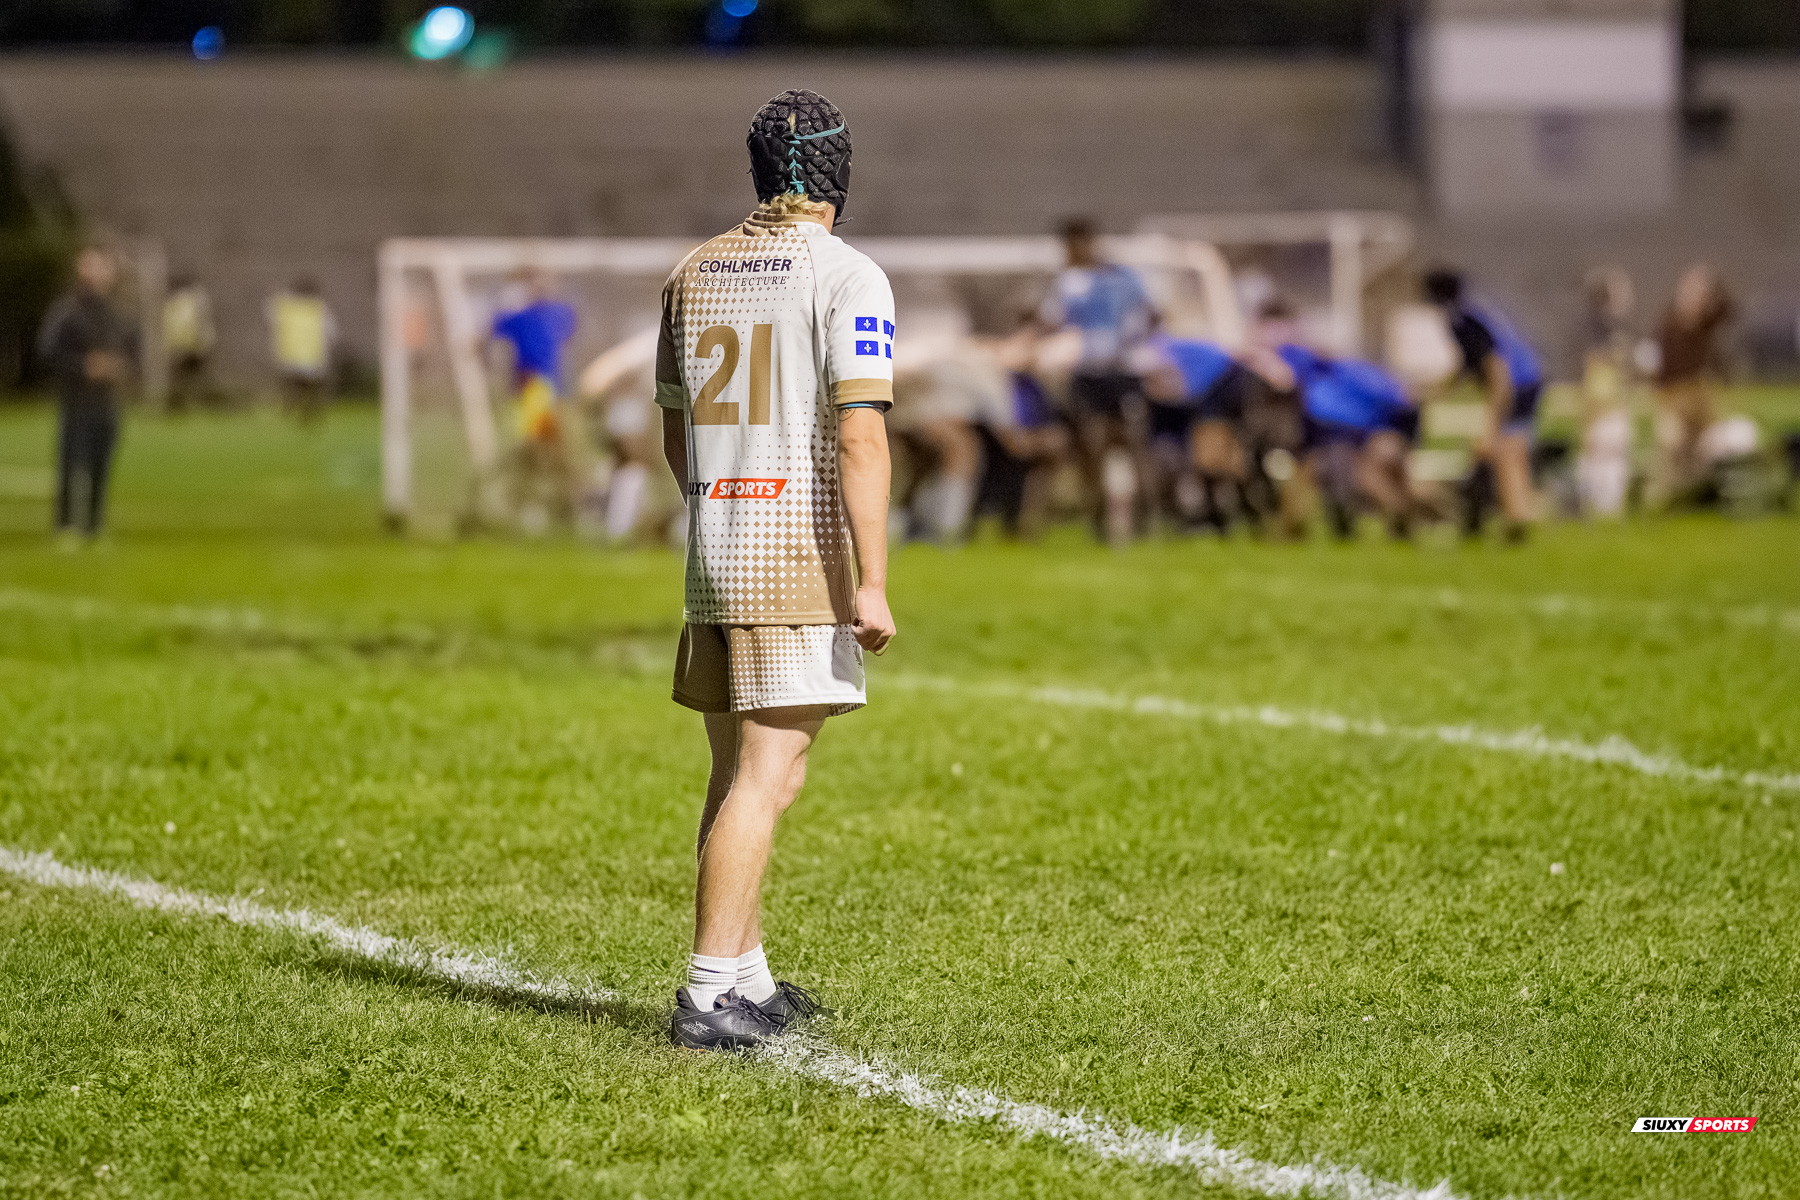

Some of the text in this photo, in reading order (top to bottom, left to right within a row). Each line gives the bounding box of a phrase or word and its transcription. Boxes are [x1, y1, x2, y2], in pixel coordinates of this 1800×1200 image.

[699, 258, 792, 273] COHLMEYER
[695, 275, 787, 287] ARCHITECTURE
[692, 324, 773, 425] 21
[688, 481, 777, 496] UXY SPORTS
